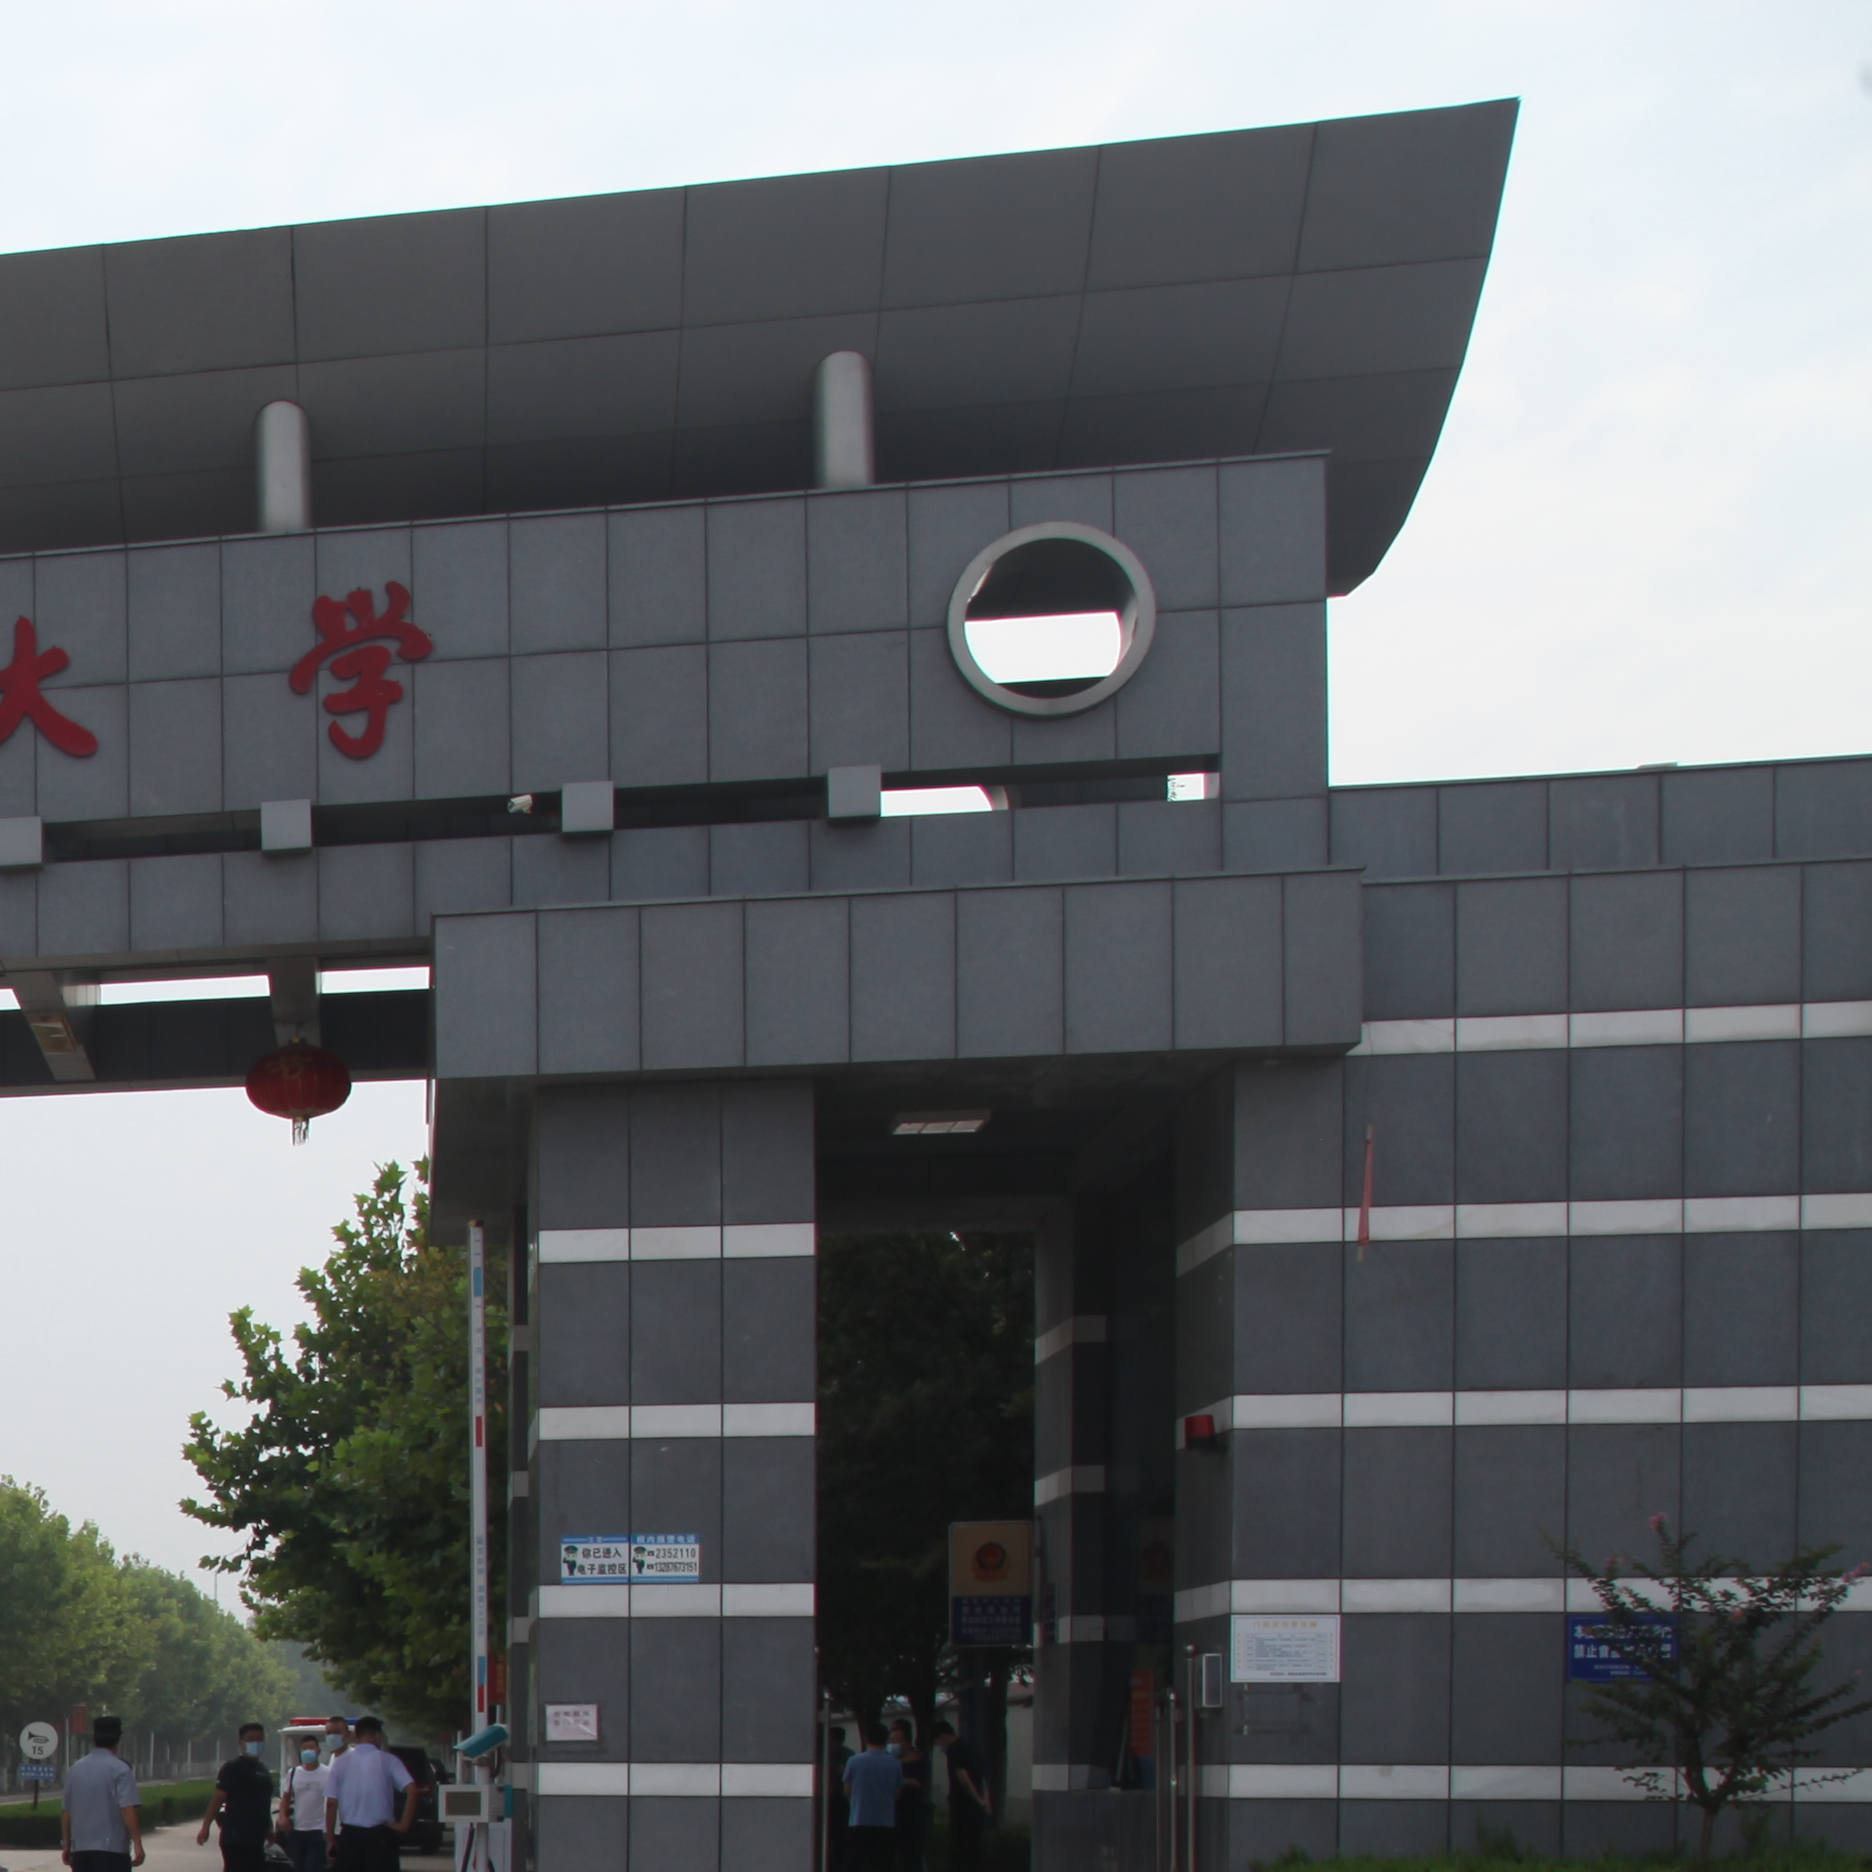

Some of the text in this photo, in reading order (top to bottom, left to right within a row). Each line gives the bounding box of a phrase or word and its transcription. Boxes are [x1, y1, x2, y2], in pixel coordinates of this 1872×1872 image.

[582, 1548, 623, 1559] 你已进入
[655, 1548, 696, 1559] 2352110
[577, 1563, 627, 1575] 电子监控区
[32, 1746, 44, 1755] 15
